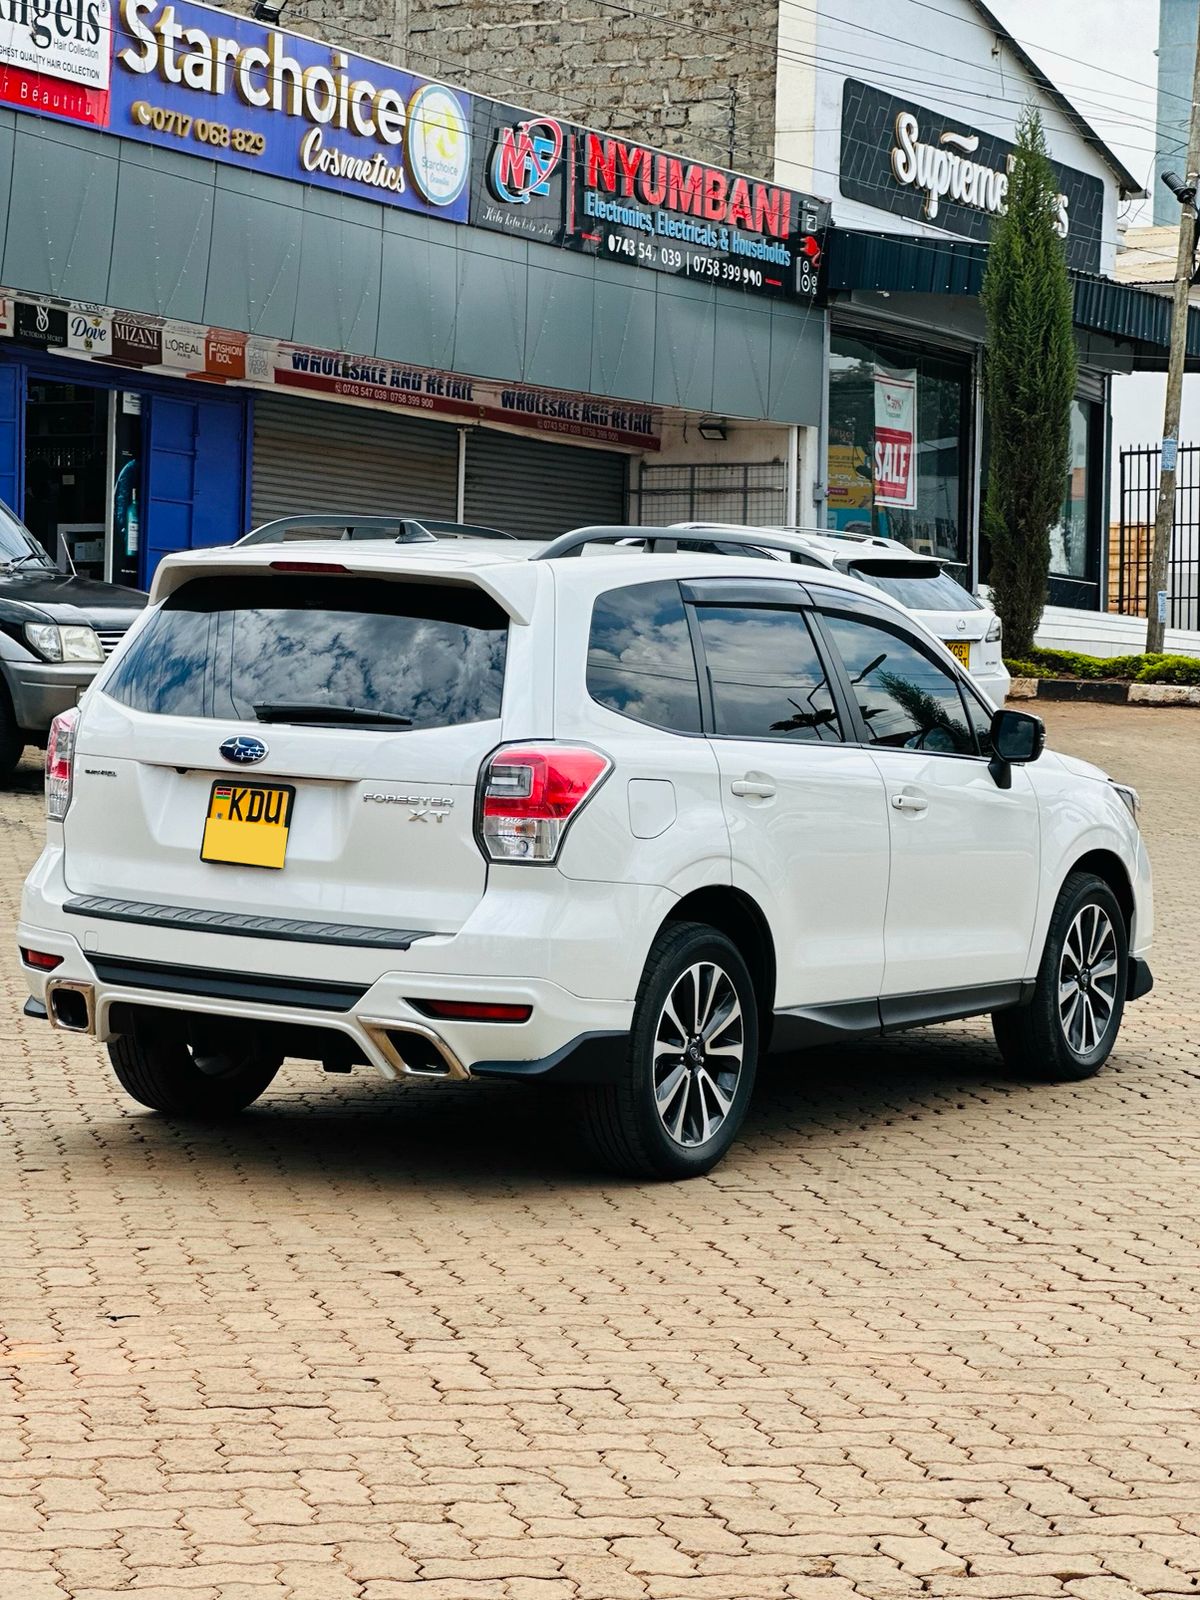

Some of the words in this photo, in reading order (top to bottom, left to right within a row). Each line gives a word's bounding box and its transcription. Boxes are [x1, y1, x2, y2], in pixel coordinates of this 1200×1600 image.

[0, 0, 100, 49] ngels
[20, 51, 46, 66] QUALITY
[47, 58, 61, 70] HAIR
[62, 62, 100, 79] COLLECTION
[53, 39, 67, 50] Hair
[69, 41, 99, 58] Collection
[118, 0, 406, 145] Starchoice
[152, 107, 192, 137] 0717
[194, 118, 231, 148] 068
[231, 127, 266, 156] 829
[301, 127, 405, 193] Cosmetics
[585, 132, 791, 239] NYUMBANI
[584, 191, 654, 236] Electronics,
[655, 212, 717, 250] Electricals
[717, 228, 729, 251] &
[732, 232, 791, 267] Households
[608, 234, 635, 257] 0743
[661, 248, 681, 267] 039
[693, 255, 720, 277] 0758
[722, 263, 741, 282] 399
[46, 333, 63, 343] SECRET
[71, 316, 107, 341] Dove
[115, 323, 160, 346] MIZANI
[209, 342, 242, 360] FASHION
[216, 352, 232, 365] IDOL
[291, 352, 387, 385] WHOLESALE
[389, 367, 422, 393] AND
[425, 374, 474, 401] RETAIL
[342, 383, 359, 395] 0743
[360, 387, 373, 397] 547
[374, 389, 387, 400] 039
[390, 392, 406, 404] 0758
[408, 395, 420, 406] 399
[421, 399, 434, 409] 900
[501, 390, 580, 421] WHOLESALE
[582, 404, 608, 426] AND
[611, 410, 653, 434] RETAIL
[875, 441, 907, 484] SALE
[228, 788, 283, 824] KDU
[363, 793, 454, 808] FORESTER
[408, 809, 450, 823] XT
